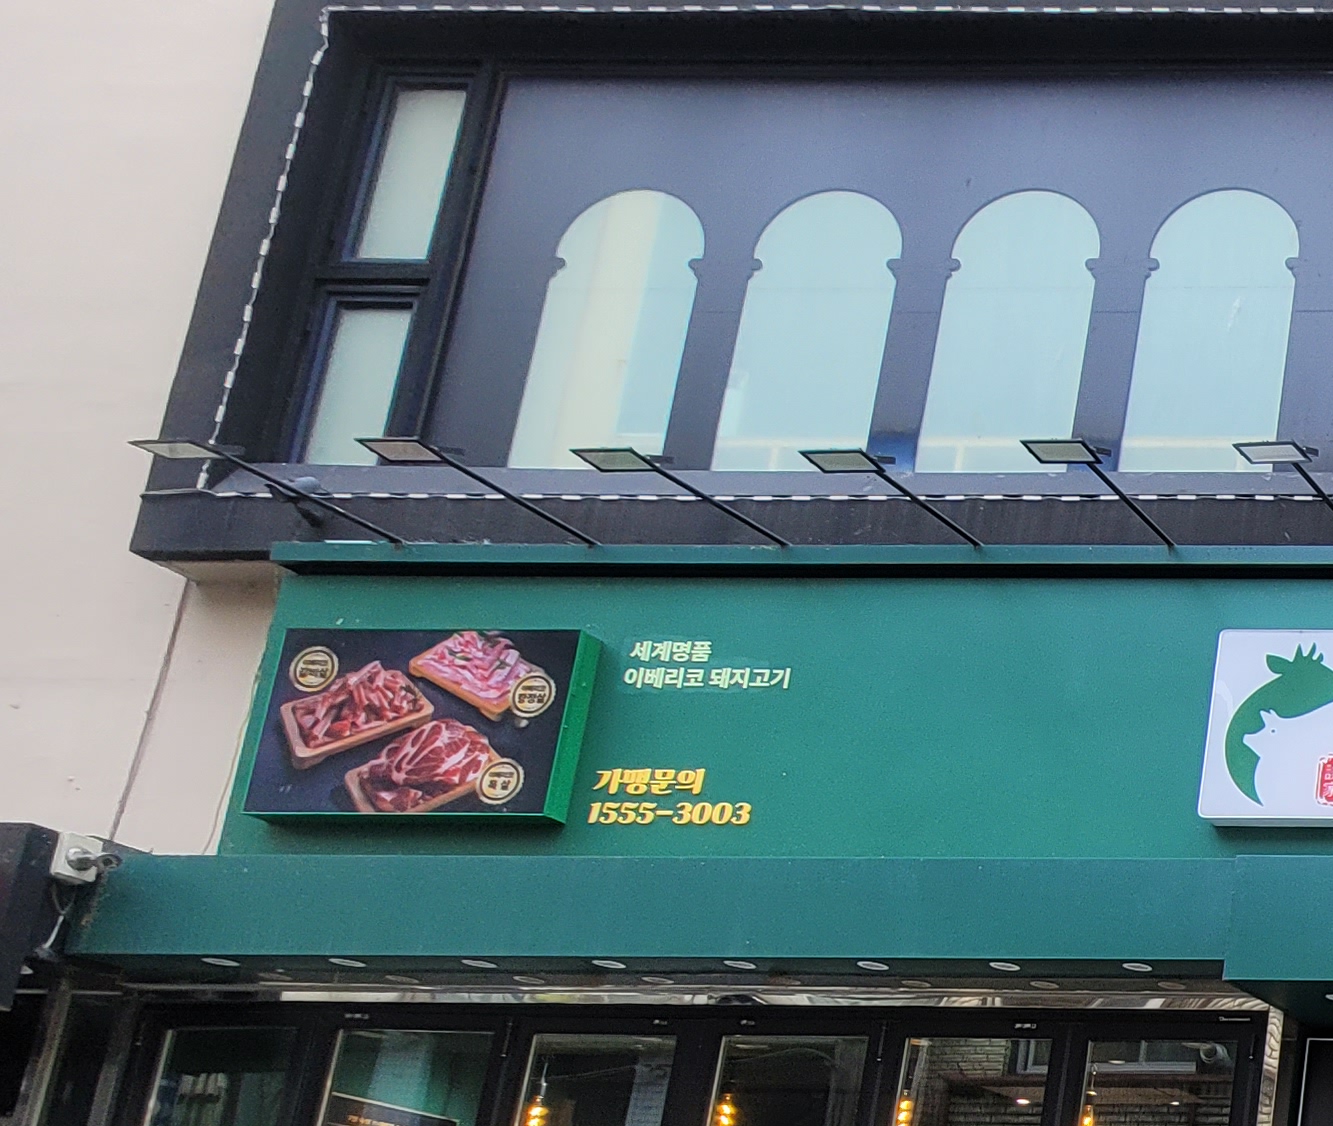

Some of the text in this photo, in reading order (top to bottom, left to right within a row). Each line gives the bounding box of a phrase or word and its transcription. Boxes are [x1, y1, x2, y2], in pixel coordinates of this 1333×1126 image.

[629, 639, 713, 664] 세계명품
[623, 665, 791, 691] 이베리코 돼지고기
[593, 768, 706, 796] 가맹문의
[587, 801, 752, 826] 1555-3003
